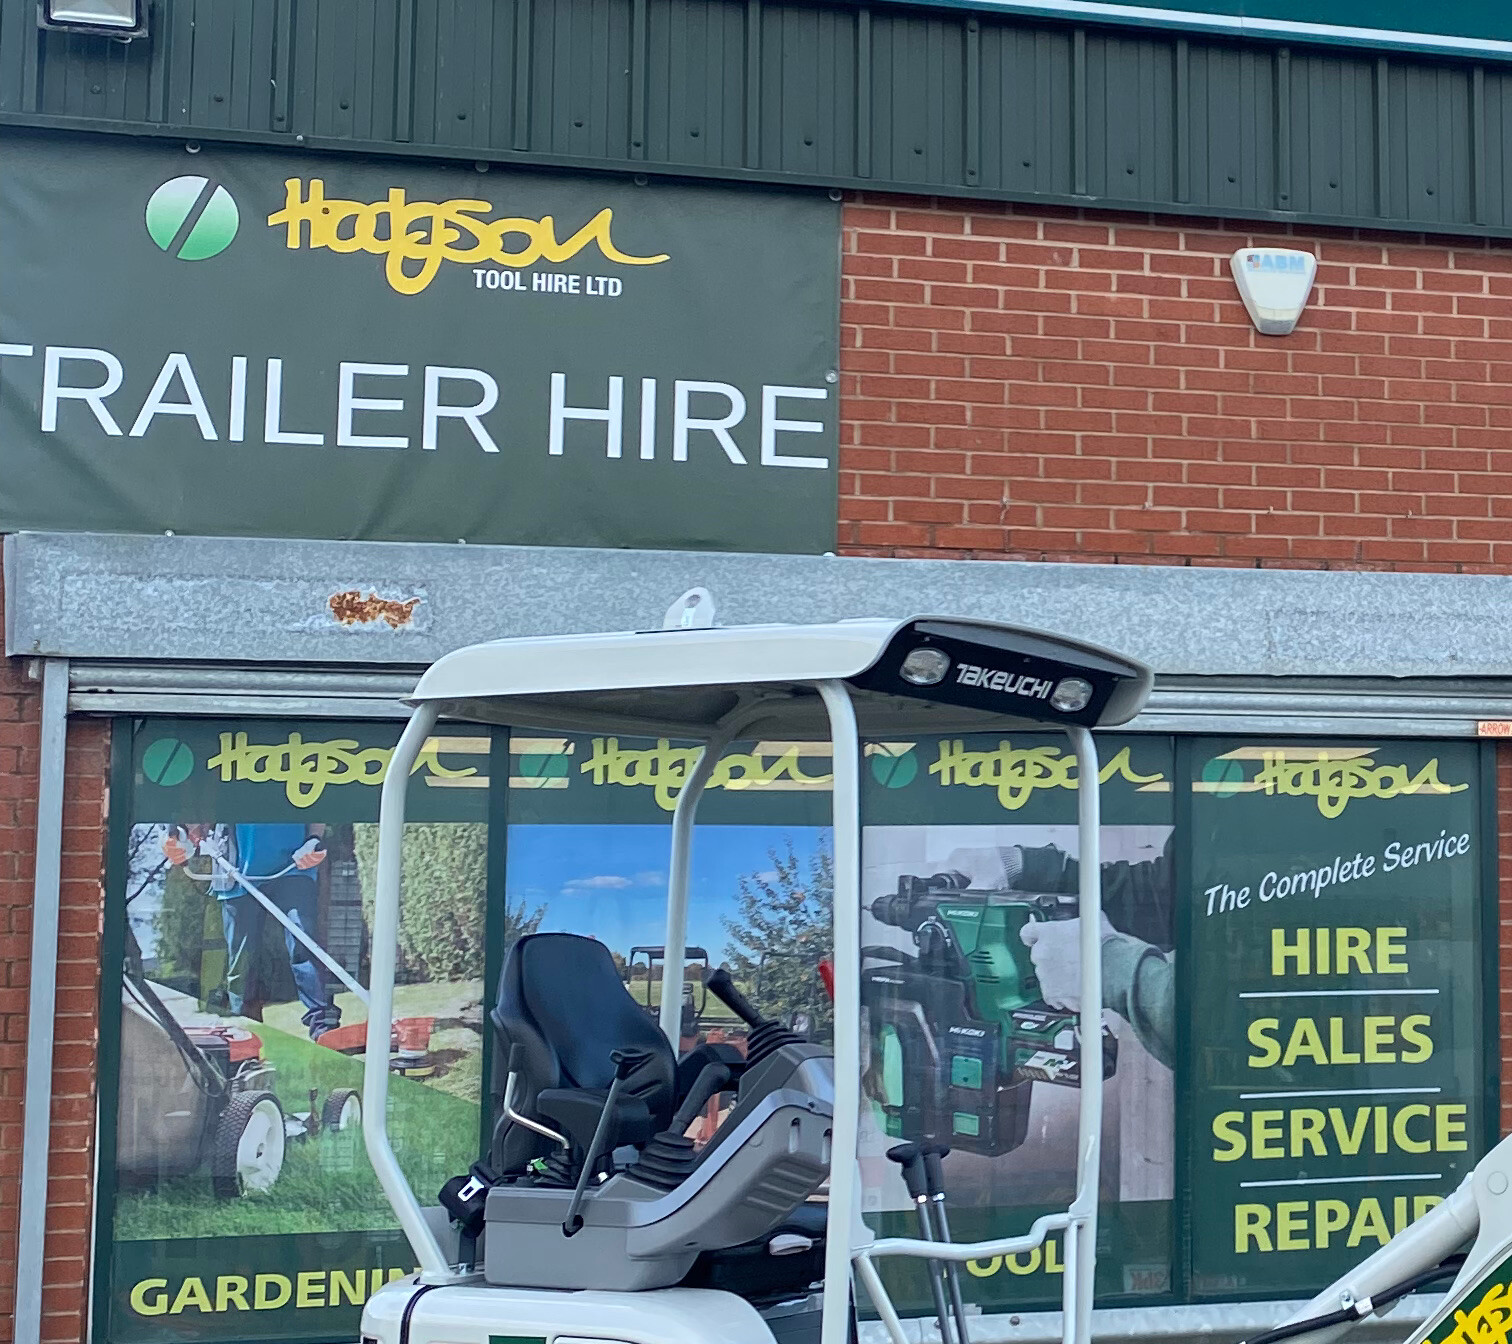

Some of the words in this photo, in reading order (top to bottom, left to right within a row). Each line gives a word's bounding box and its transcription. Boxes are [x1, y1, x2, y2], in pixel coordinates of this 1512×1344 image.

[267, 177, 671, 295] Hodgson
[472, 268, 527, 293] TOOL
[532, 271, 581, 295] HIRE
[585, 274, 623, 298] LTD
[548, 371, 829, 469] HIRE
[1253, 751, 1470, 819] Hodgson
[1203, 883, 1251, 917] The
[1258, 853, 1376, 899] Complete
[1382, 829, 1471, 873] Service
[1271, 927, 1409, 976] HIRE
[1247, 1014, 1434, 1068] SALES
[1211, 1103, 1468, 1162] SERVICE
[130, 1266, 422, 1316] GARDENI
